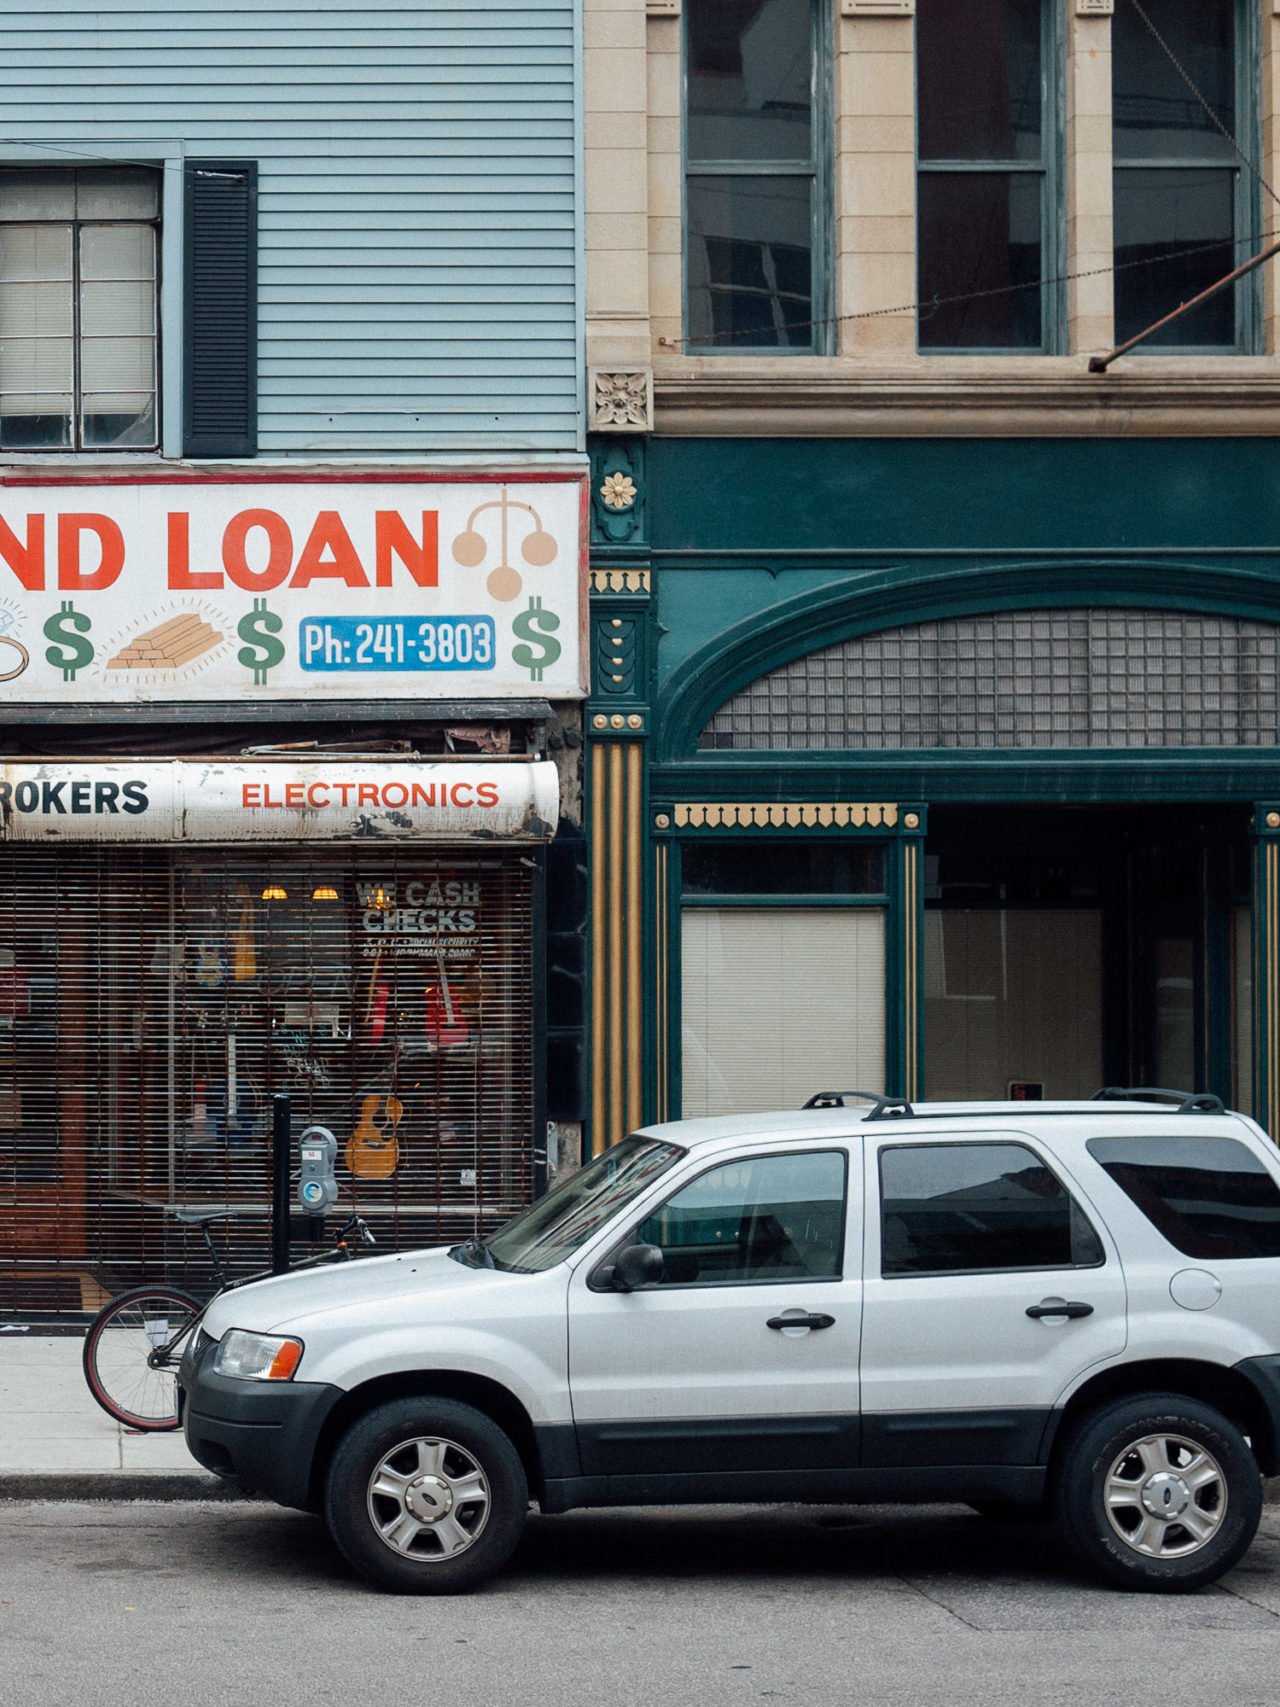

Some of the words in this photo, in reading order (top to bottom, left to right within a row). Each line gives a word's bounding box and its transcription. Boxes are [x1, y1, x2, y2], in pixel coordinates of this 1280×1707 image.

[167, 508, 439, 592] LOAN
[305, 624, 351, 664] Ph:
[355, 623, 492, 664] 241-3803
[242, 781, 499, 809] ELECTRONICS
[355, 882, 397, 906] WE
[405, 881, 480, 907] CASH
[362, 909, 477, 932] CHECKS
